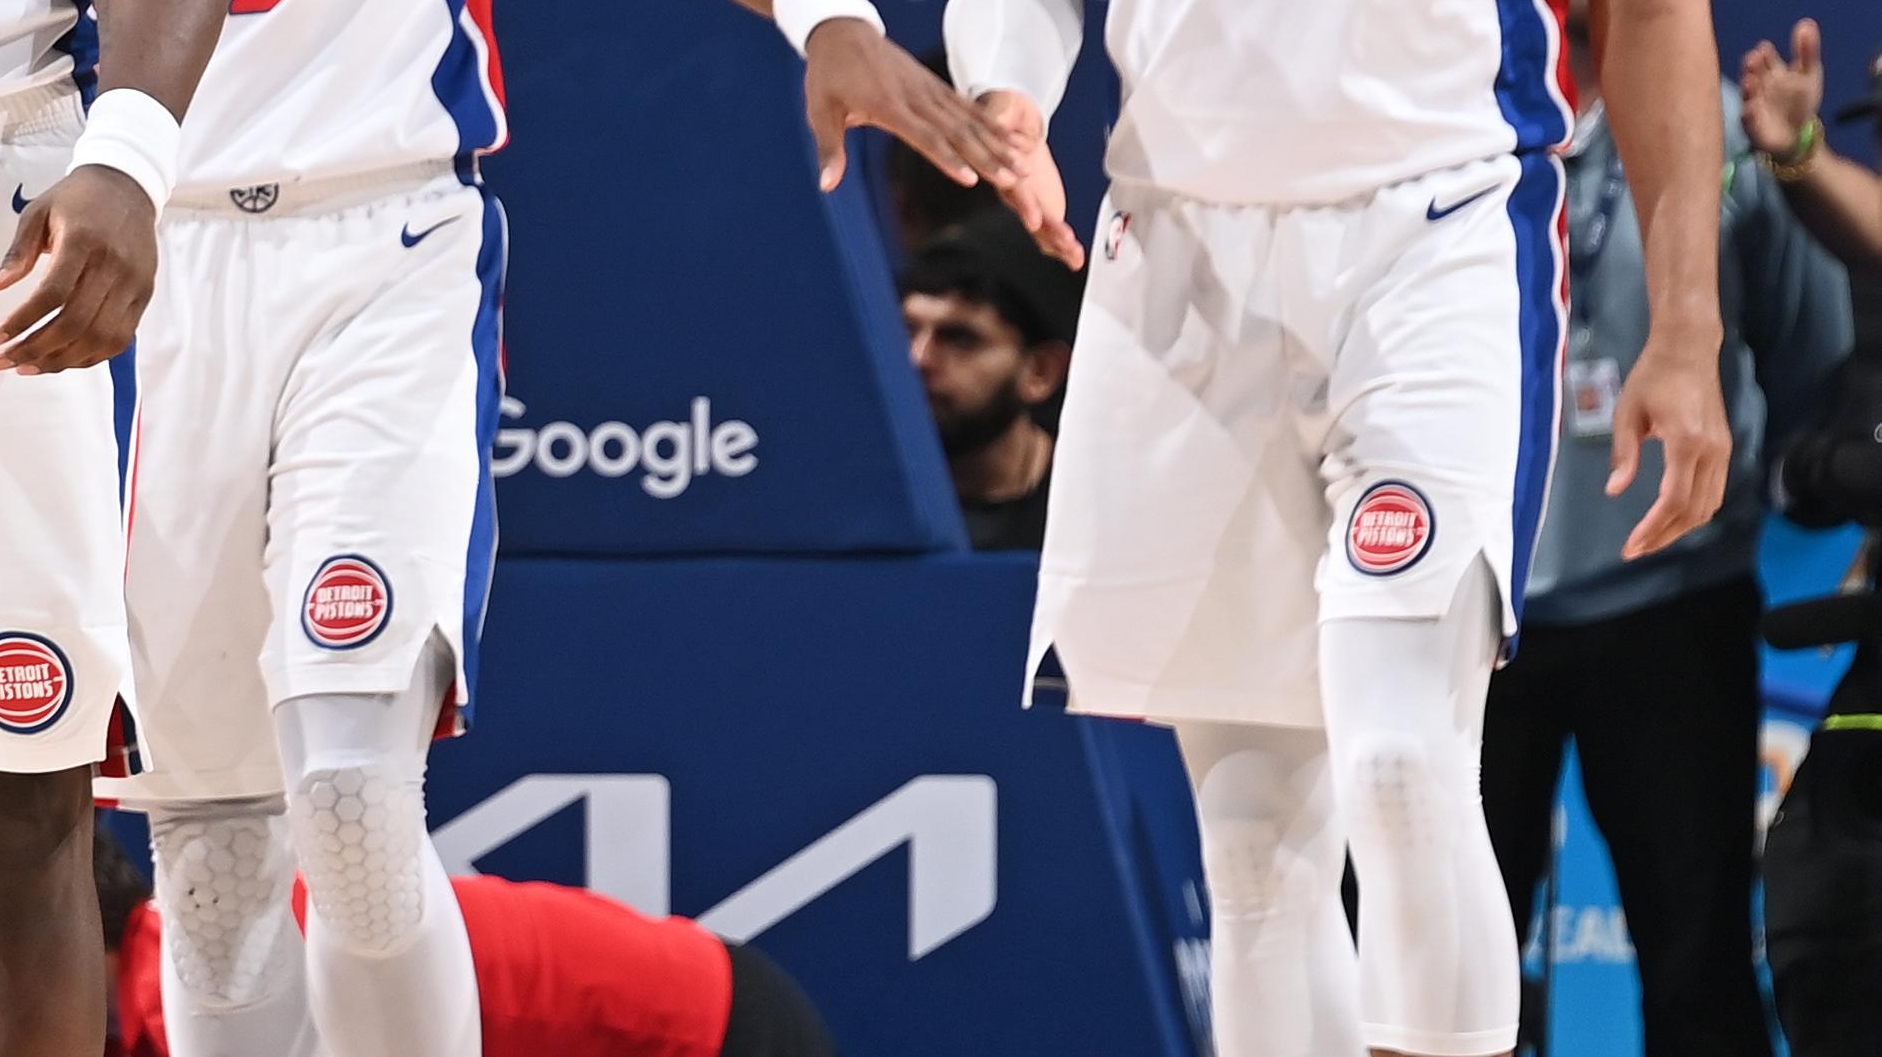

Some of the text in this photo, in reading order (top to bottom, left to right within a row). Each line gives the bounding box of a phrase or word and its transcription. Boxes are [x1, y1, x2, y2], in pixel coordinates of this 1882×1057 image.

[490, 395, 760, 500] Google
[317, 585, 374, 604] DETROIT
[314, 601, 374, 622] PISTONS
